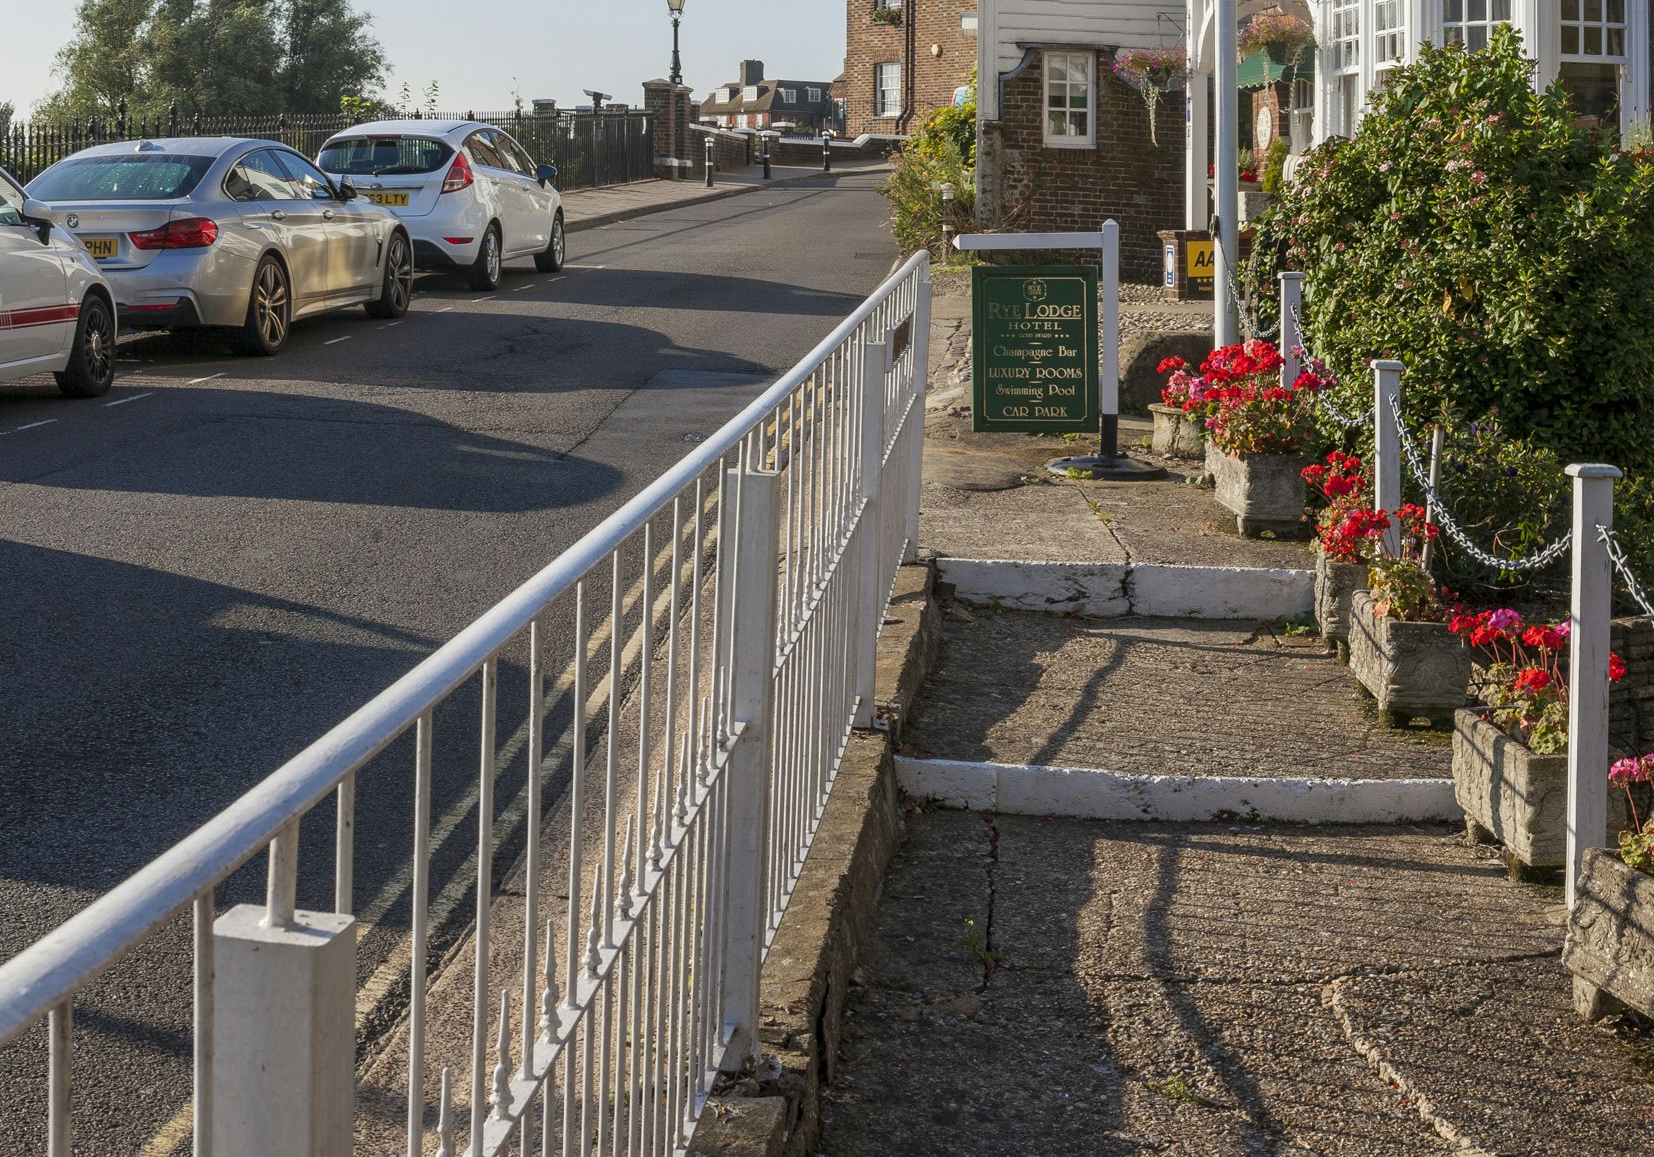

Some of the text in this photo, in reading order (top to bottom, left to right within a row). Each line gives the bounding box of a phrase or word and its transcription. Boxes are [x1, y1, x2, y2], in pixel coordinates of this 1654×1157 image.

[385, 194, 407, 204] LTY
[988, 302, 1082, 319] RYE LODGE
[1008, 321, 1062, 331] HOTEL
[993, 345, 1078, 360] Champagne Bar
[988, 367, 1083, 379] LUXURY ROOMS
[995, 383, 1076, 399] Swimming Pool
[1002, 406, 1069, 417] CAR PARK
